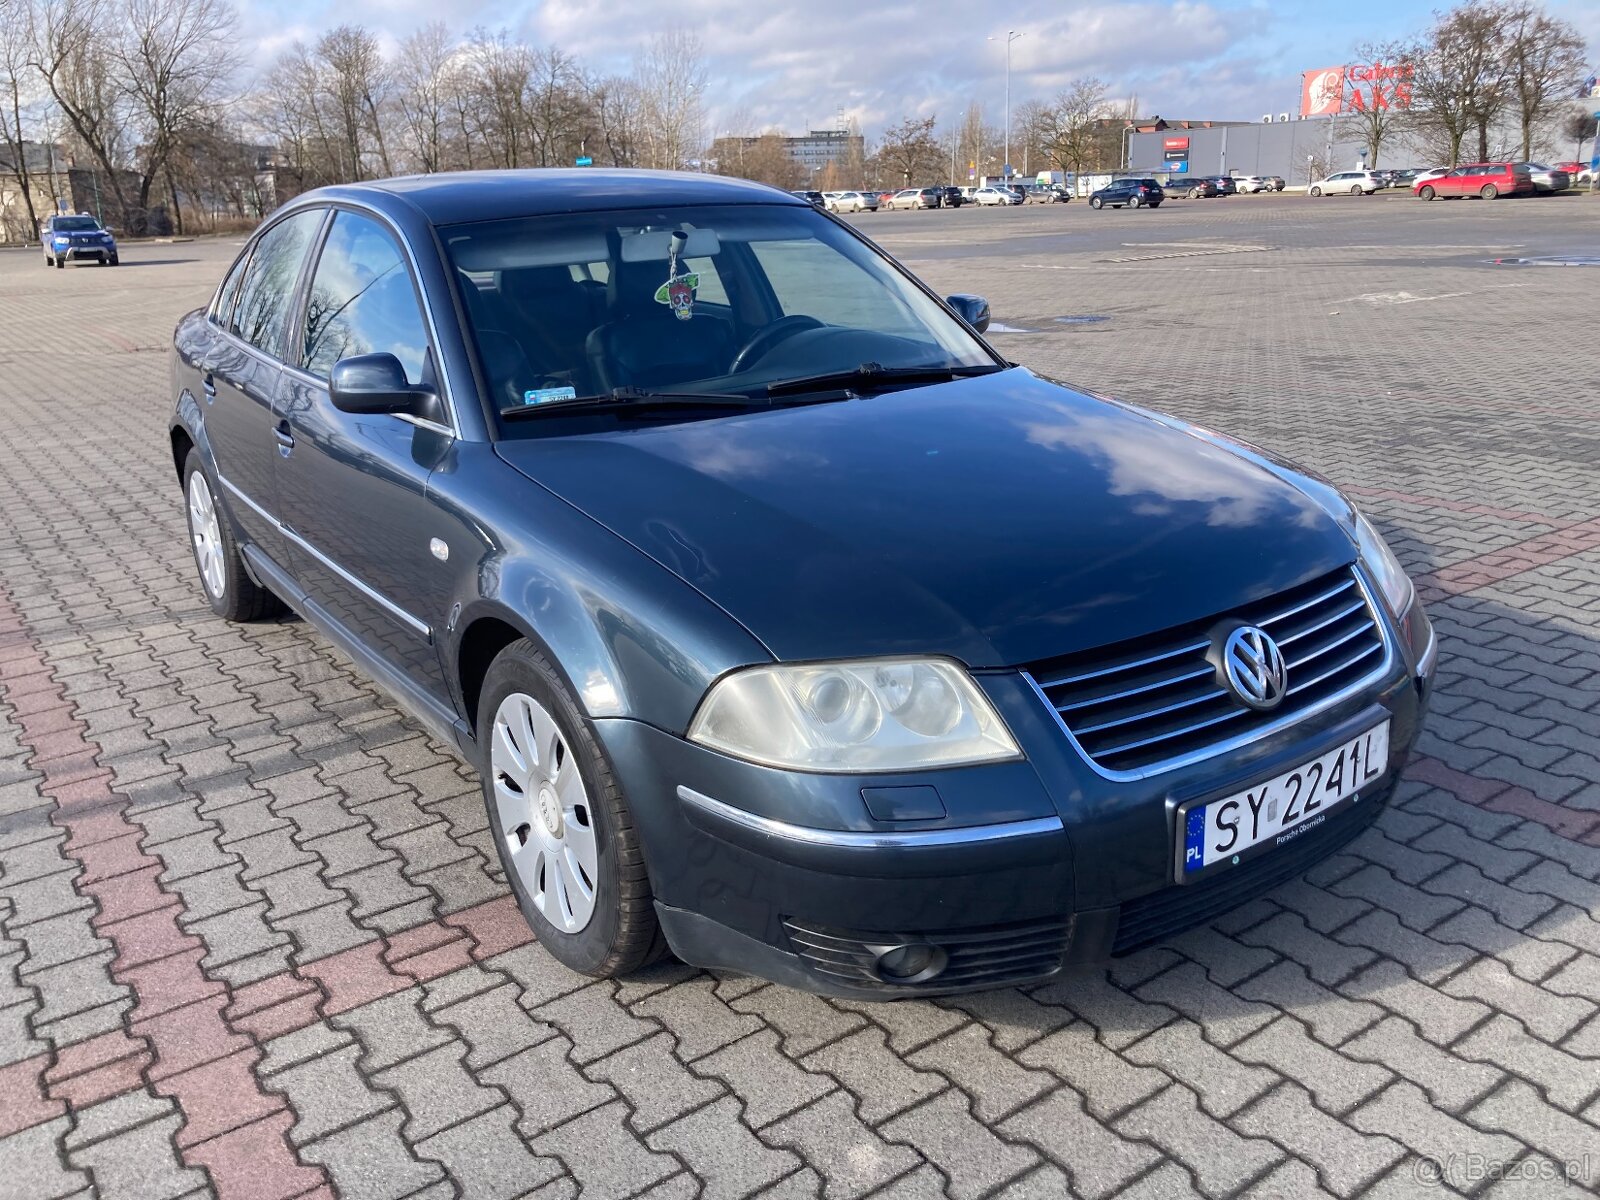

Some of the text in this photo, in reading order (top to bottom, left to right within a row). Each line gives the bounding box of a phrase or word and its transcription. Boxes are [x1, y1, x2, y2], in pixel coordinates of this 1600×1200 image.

[1346, 83, 1413, 113] AKS
[1215, 734, 1379, 853] SY 2241L
[1186, 846, 1202, 863] PL
